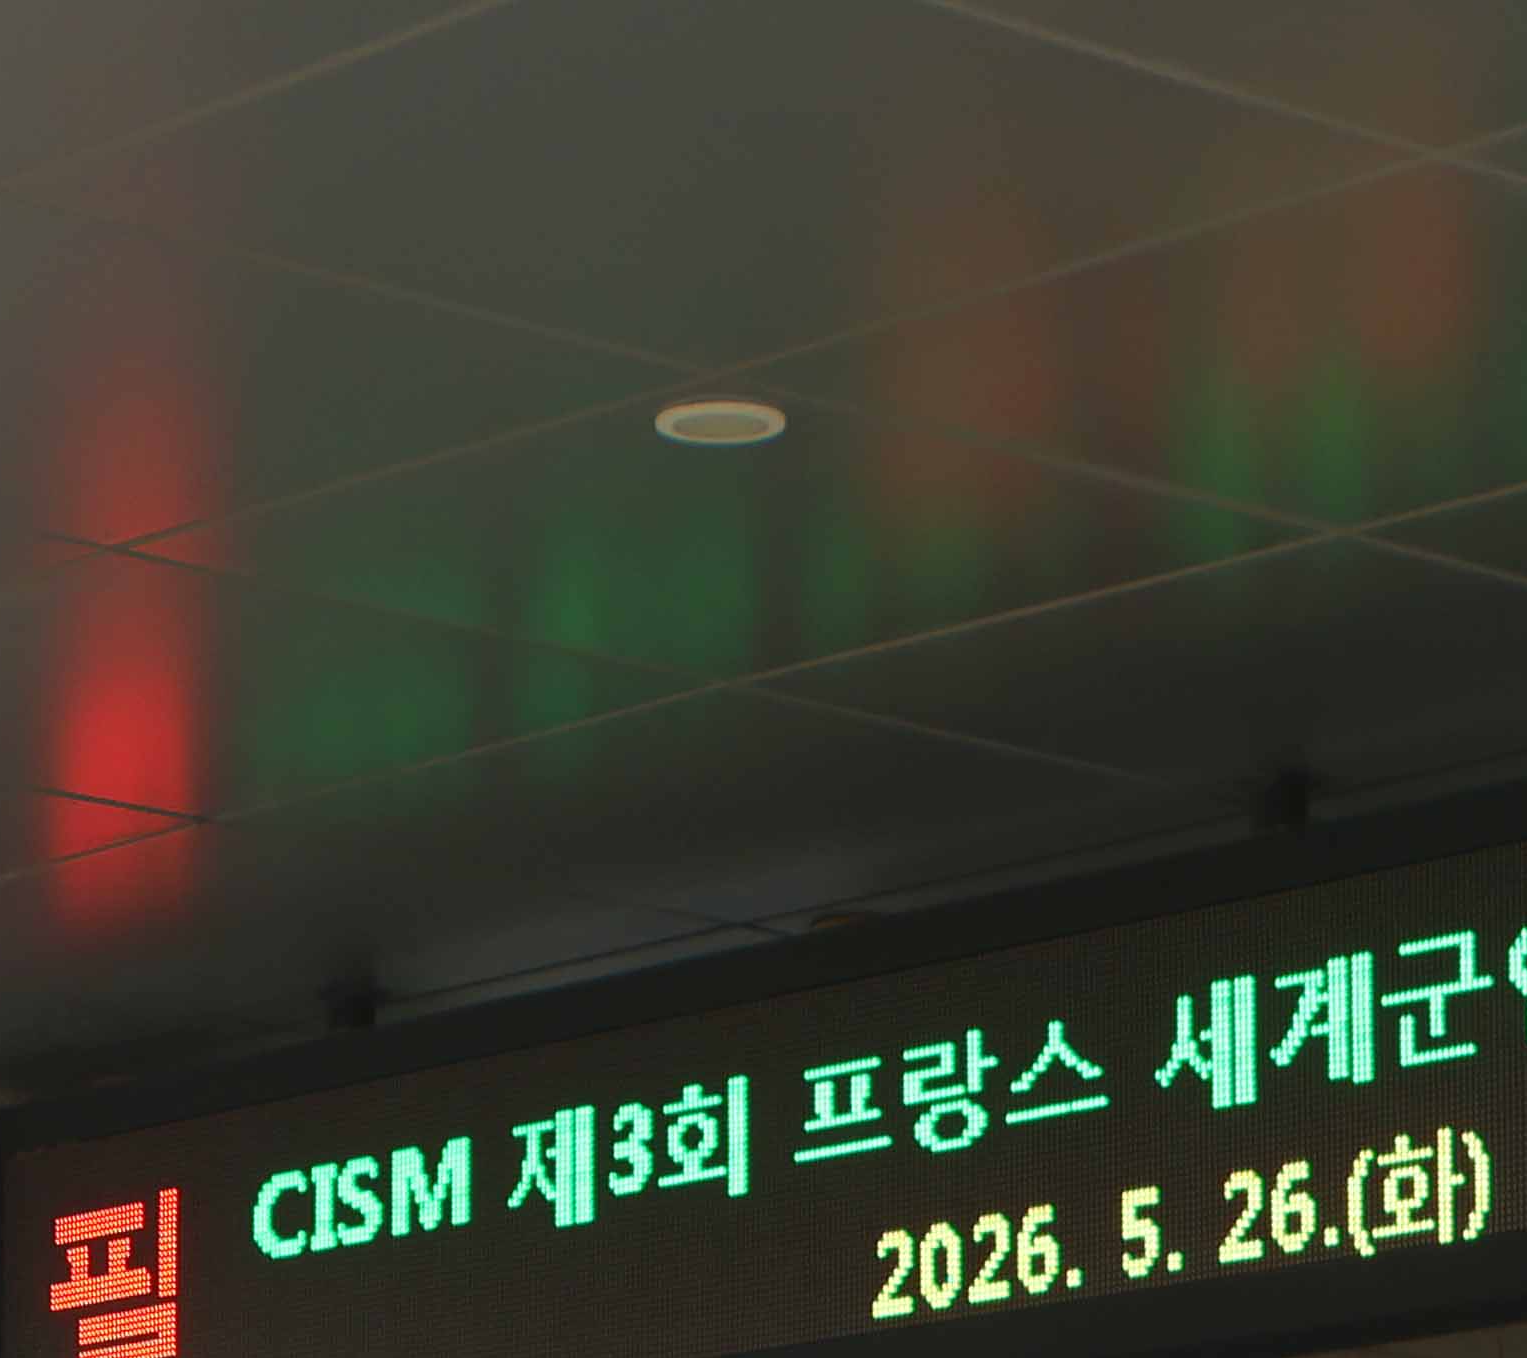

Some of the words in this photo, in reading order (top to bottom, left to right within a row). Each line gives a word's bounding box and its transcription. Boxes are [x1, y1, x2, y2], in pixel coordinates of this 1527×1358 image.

[252, 1136, 472, 1260] CISM
[507, 1074, 748, 1228] 제3회
[793, 1019, 1110, 1163] 프랑스
[871, 1203, 1083, 1319] 2026.
[1120, 1186, 1184, 1280] 5.
[1218, 1126, 1492, 1264] 26.(화)
